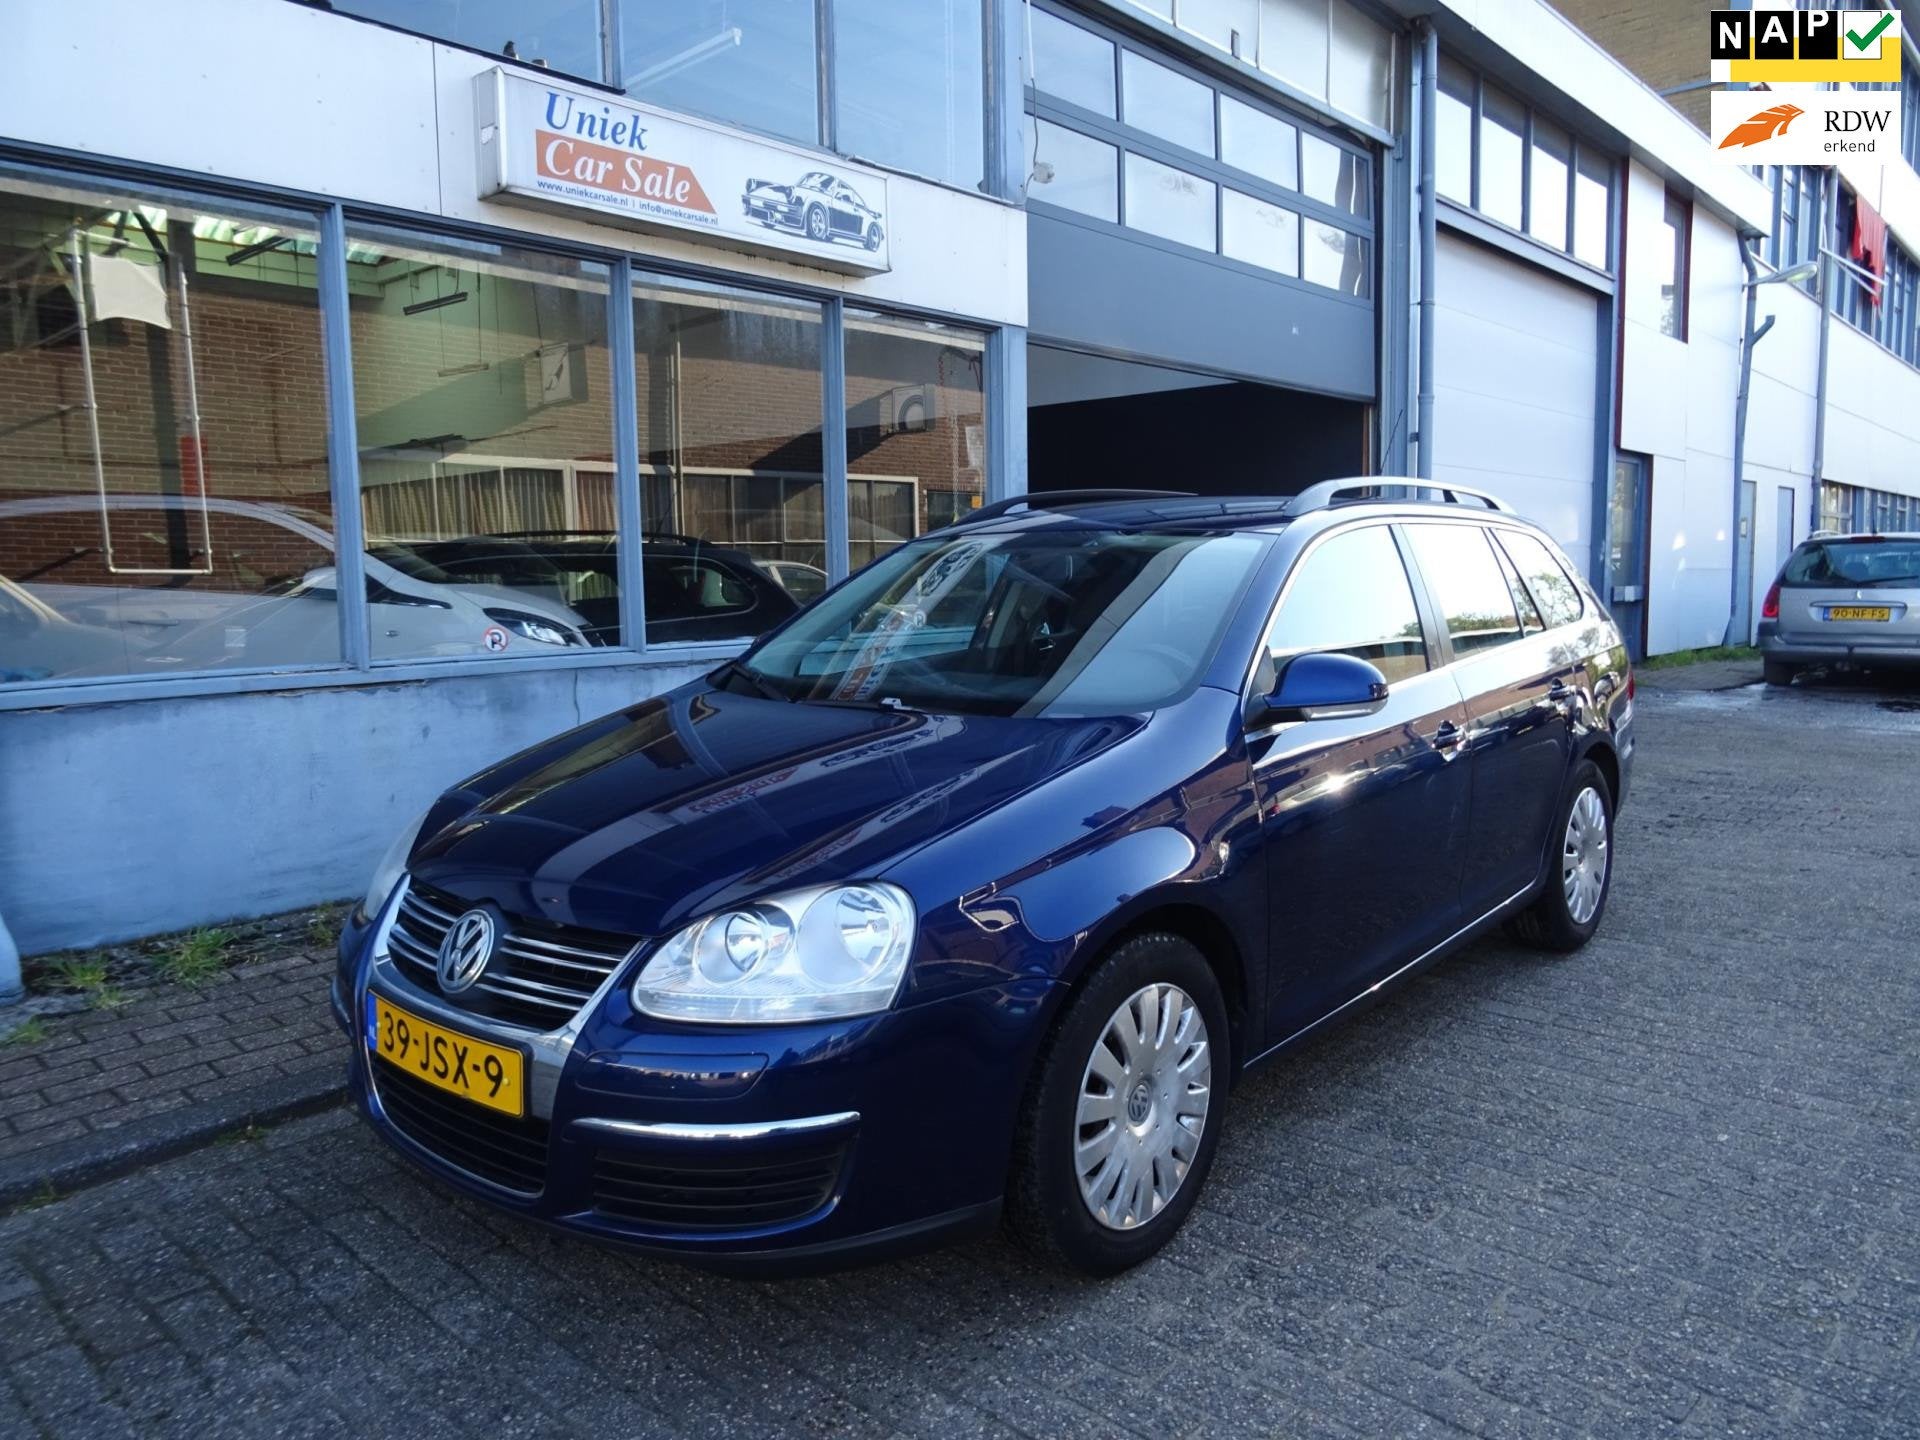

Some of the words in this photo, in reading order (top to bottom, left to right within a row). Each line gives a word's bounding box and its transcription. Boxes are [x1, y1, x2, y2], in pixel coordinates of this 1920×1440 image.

[546, 91, 648, 151] Uniek
[545, 139, 613, 184] Car
[622, 157, 691, 203] Sale
[537, 180, 629, 207] www.uniekcarsale.nl
[639, 201, 719, 226] info@uniekcarsale.nl
[383, 1010, 504, 1098] 39-JSX-9
